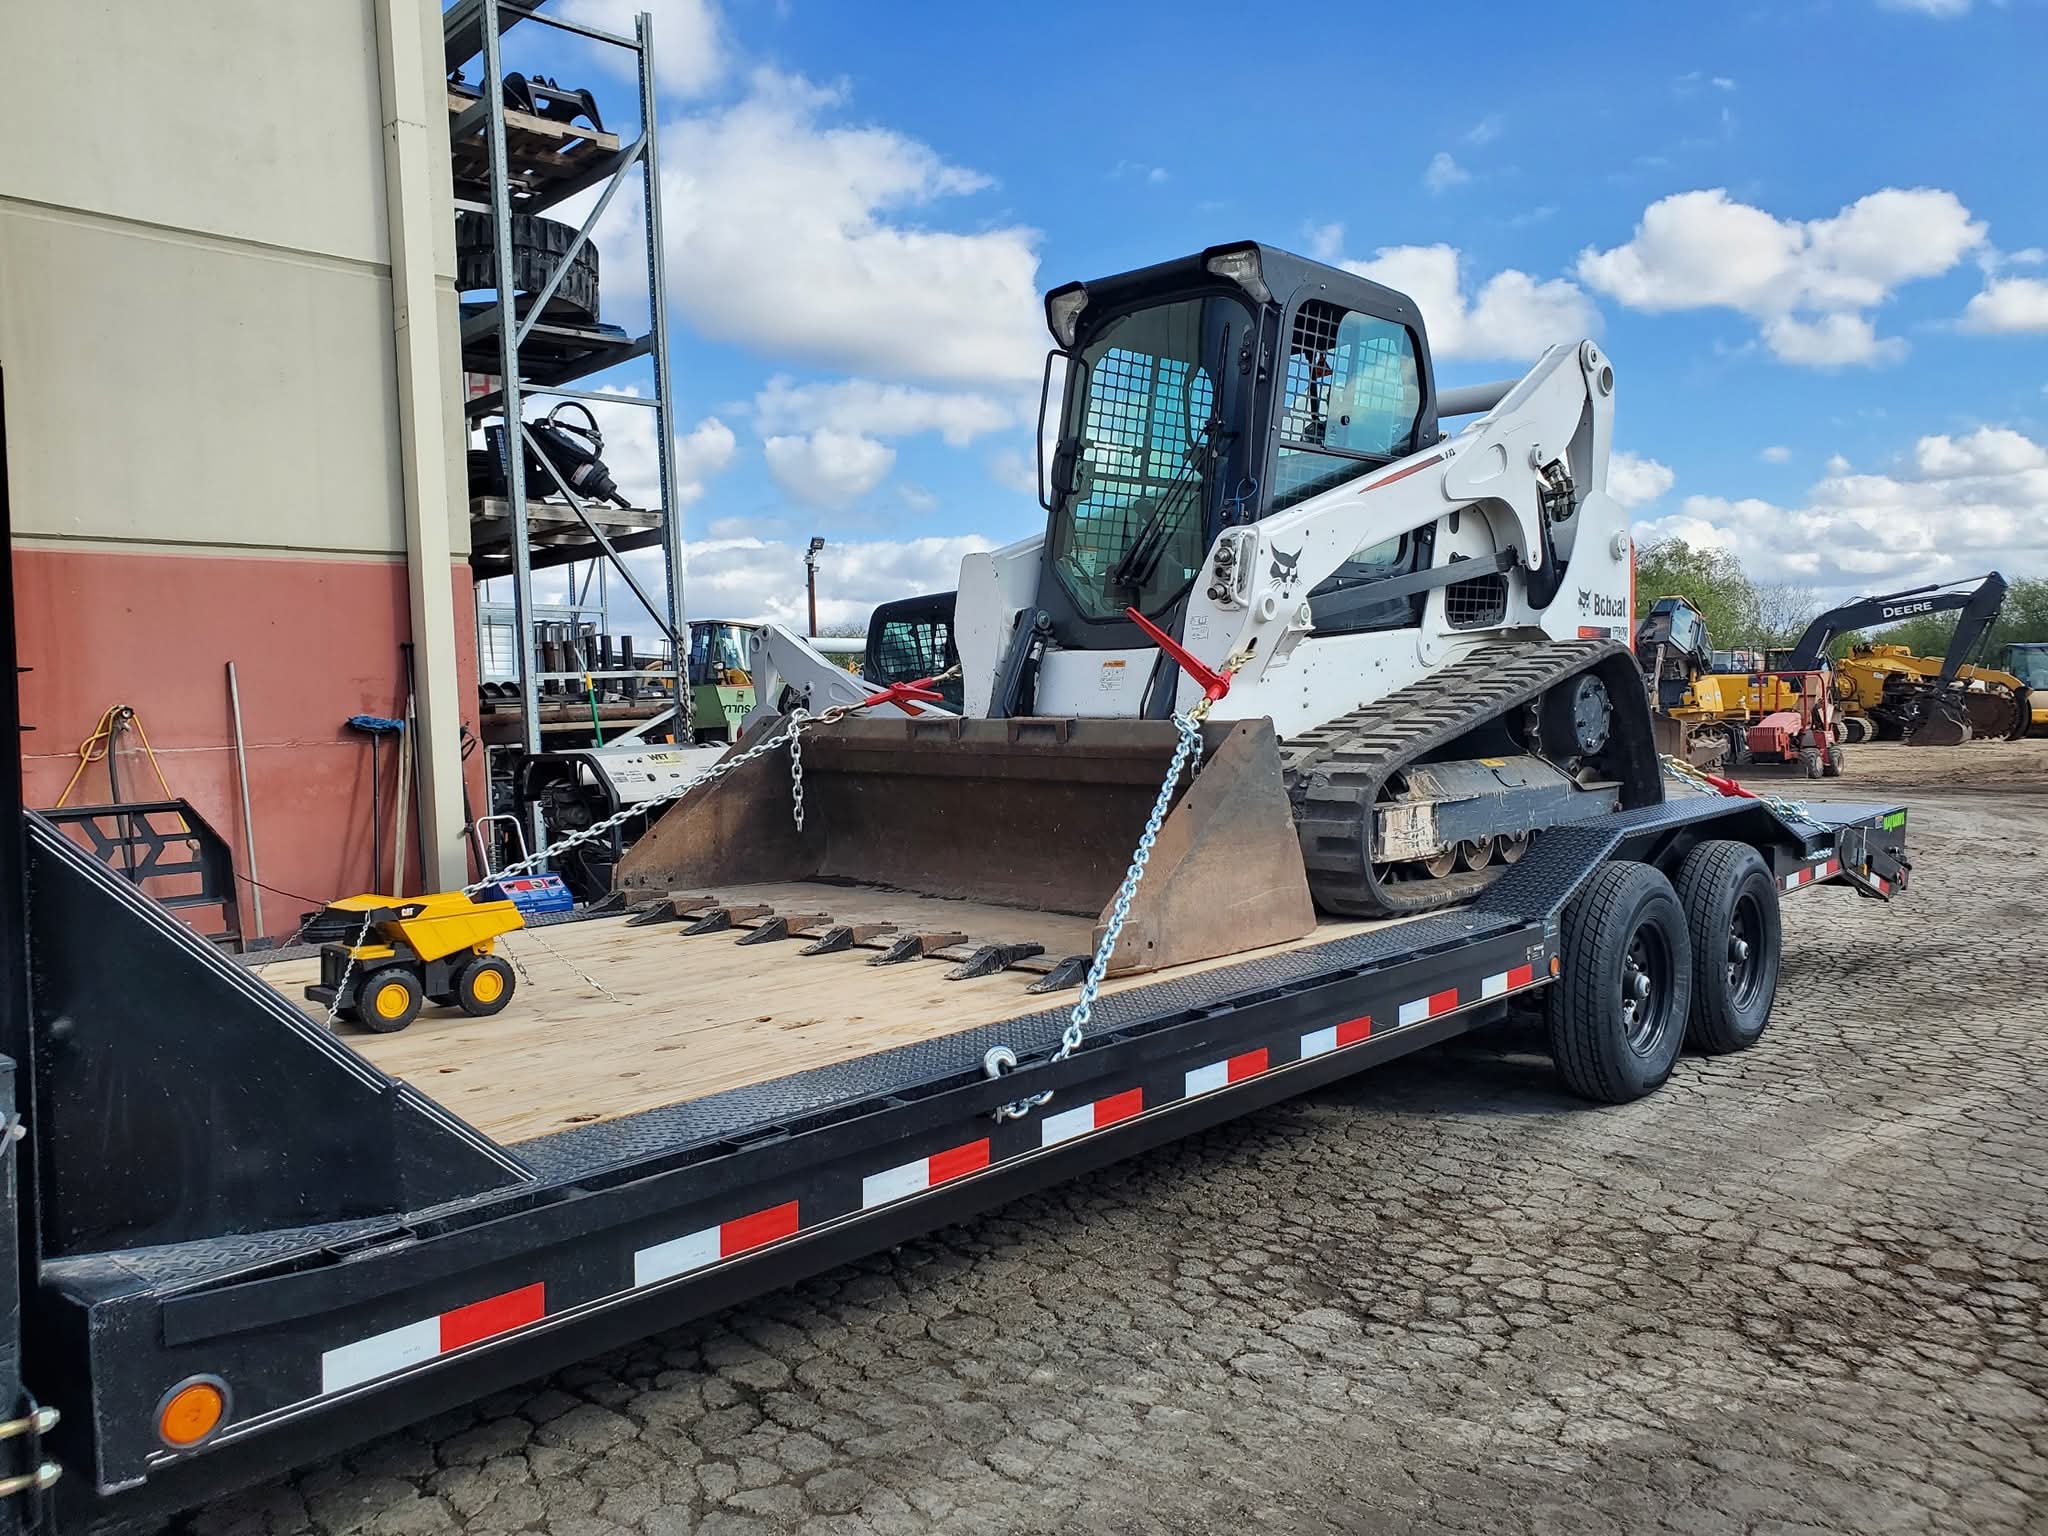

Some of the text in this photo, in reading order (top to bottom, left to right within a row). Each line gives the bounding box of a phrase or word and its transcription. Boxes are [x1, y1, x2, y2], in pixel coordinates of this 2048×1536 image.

[1594, 593, 1626, 617] Bobcat
[1882, 601, 1933, 618] DEERE
[723, 704, 751, 714] SULL
